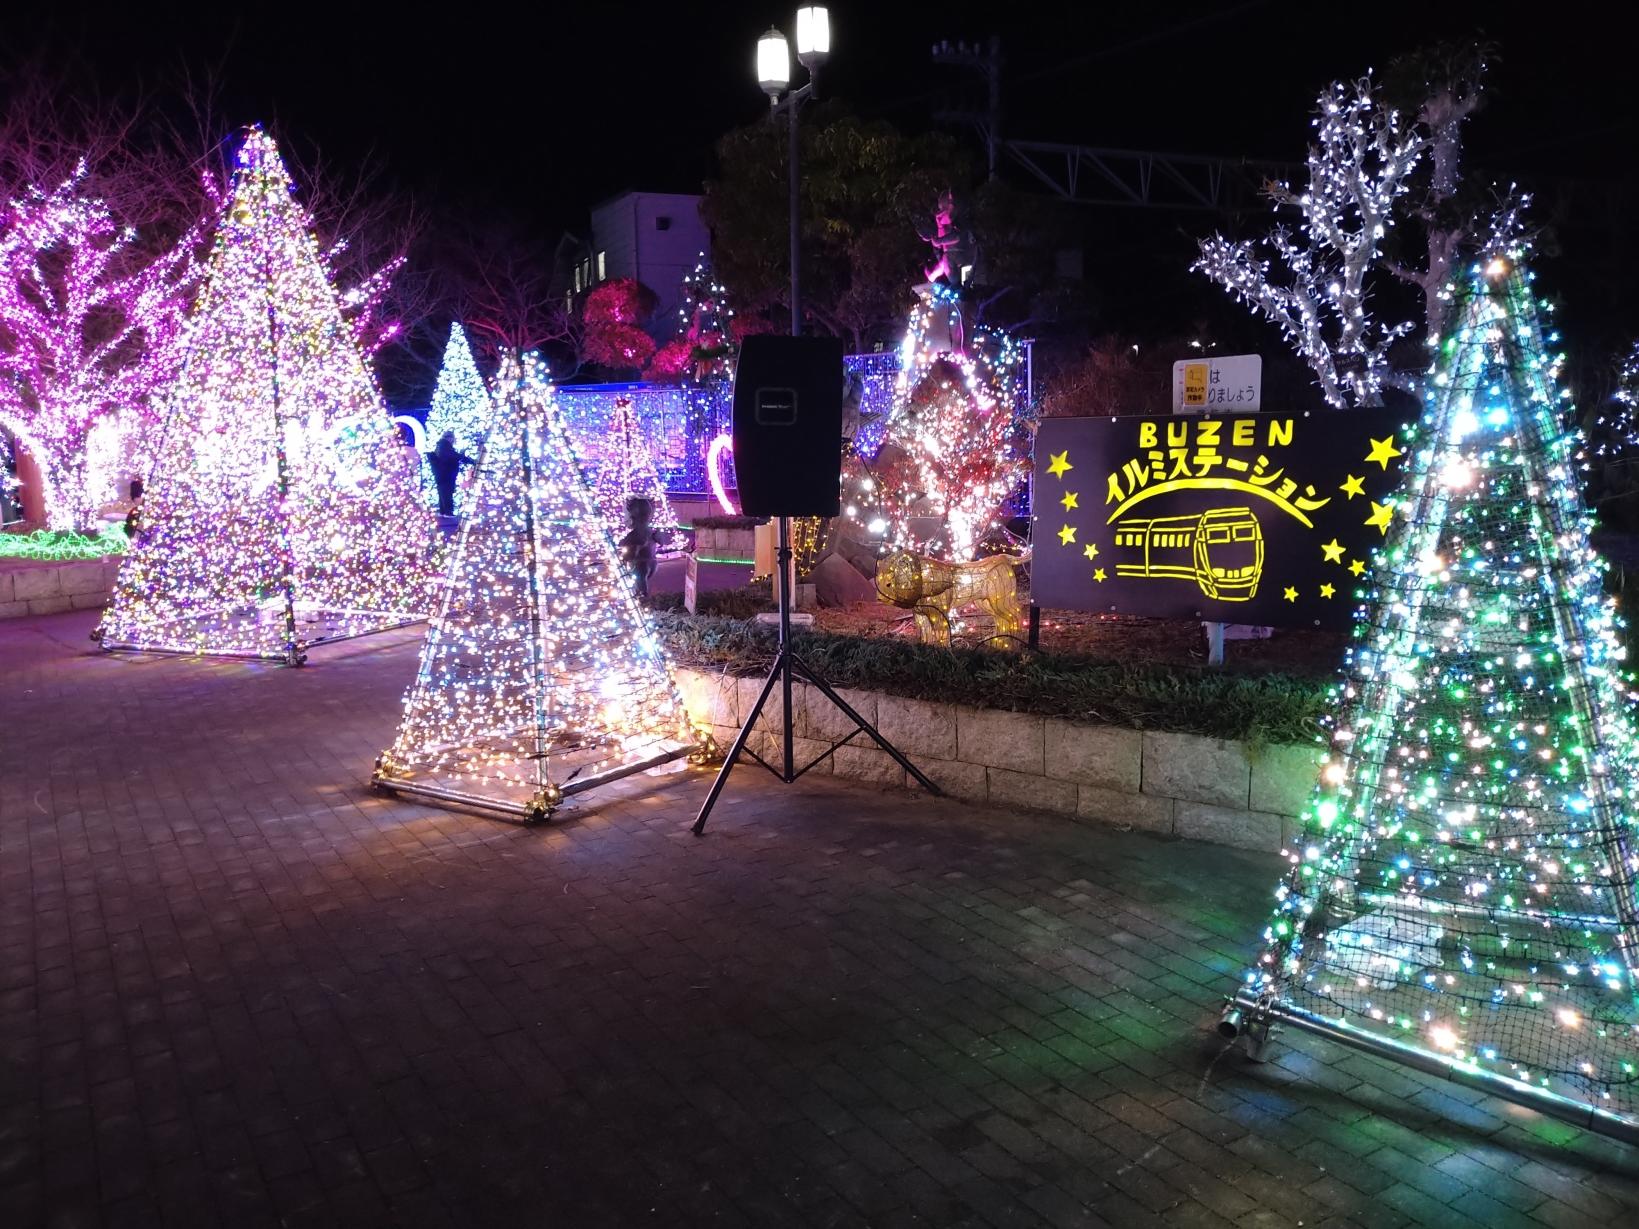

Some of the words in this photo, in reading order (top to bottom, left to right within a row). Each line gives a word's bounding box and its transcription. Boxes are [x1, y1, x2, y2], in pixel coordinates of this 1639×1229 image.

[1140, 420, 1294, 448] BUZEN
[1106, 448, 1332, 510] イルミステーション
